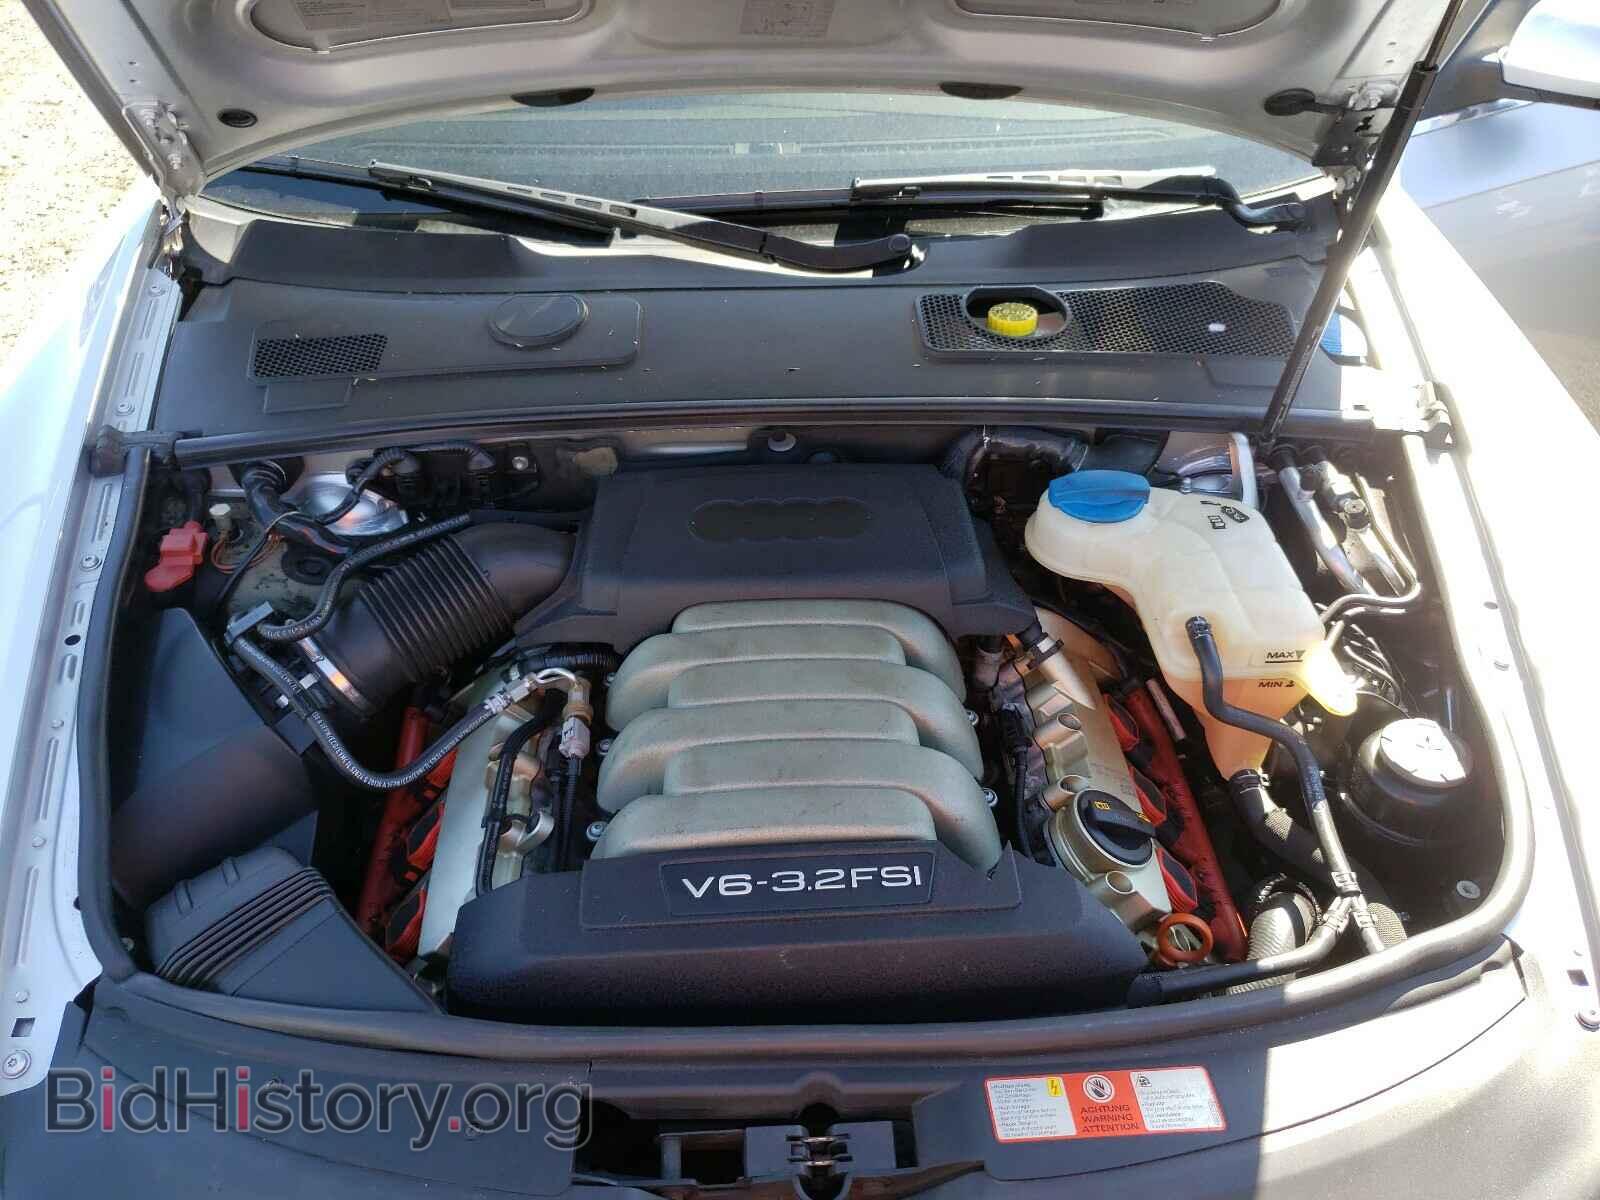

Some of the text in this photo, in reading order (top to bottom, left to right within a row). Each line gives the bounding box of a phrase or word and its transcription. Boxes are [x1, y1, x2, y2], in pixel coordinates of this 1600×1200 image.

[1266, 651, 1294, 659] MAX
[681, 865, 922, 898] V6-3.2FSI
[1081, 1104, 1130, 1114] ACHTUNG
[1081, 1113, 1134, 1123] WARNING
[1082, 1122, 1138, 1133] ATTENTION
